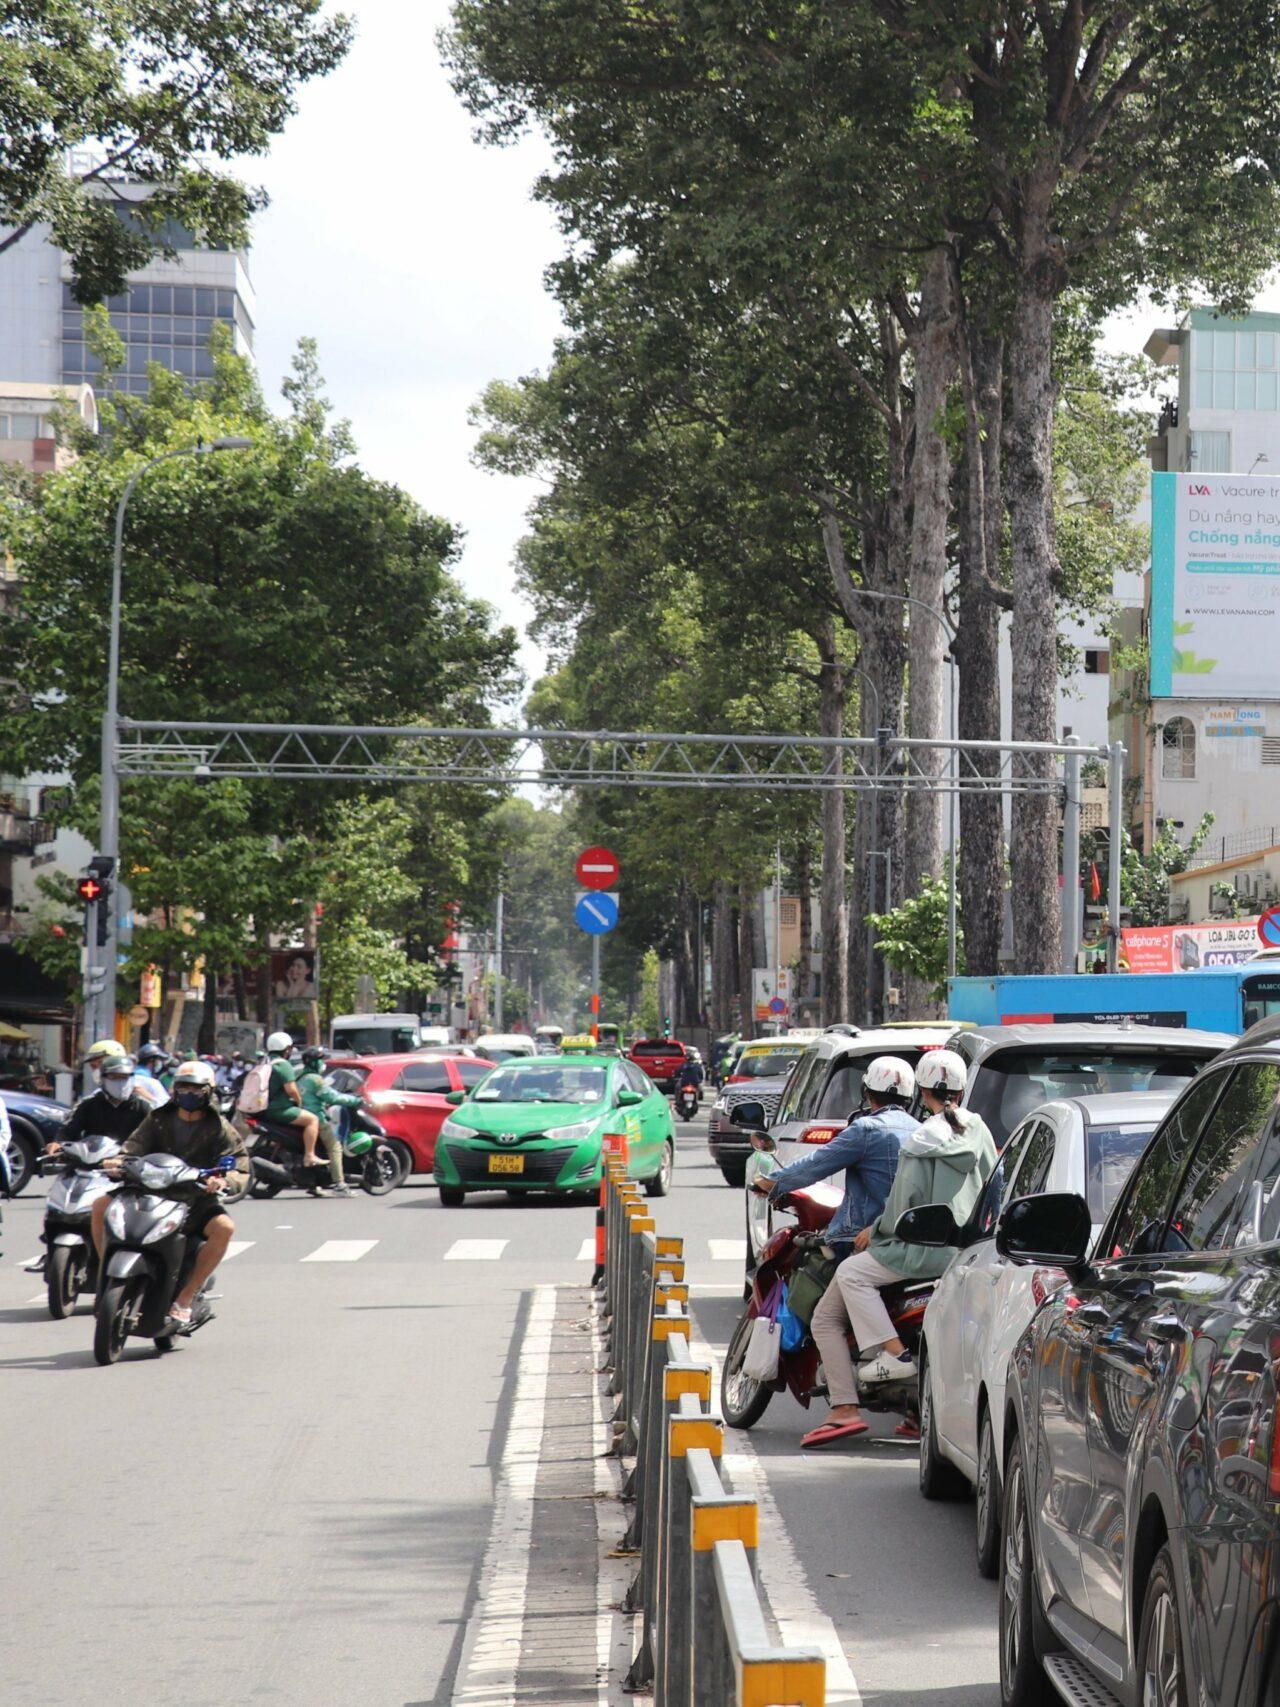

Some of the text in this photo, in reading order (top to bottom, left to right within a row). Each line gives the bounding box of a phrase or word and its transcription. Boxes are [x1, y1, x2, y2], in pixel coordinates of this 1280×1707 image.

[1188, 484, 1210, 496] LVA
[1221, 486, 1266, 497] Vacure
[1189, 508, 1210, 523] Dù
[1188, 528, 1239, 546] Chống
[1237, 929, 1249, 941] GO
